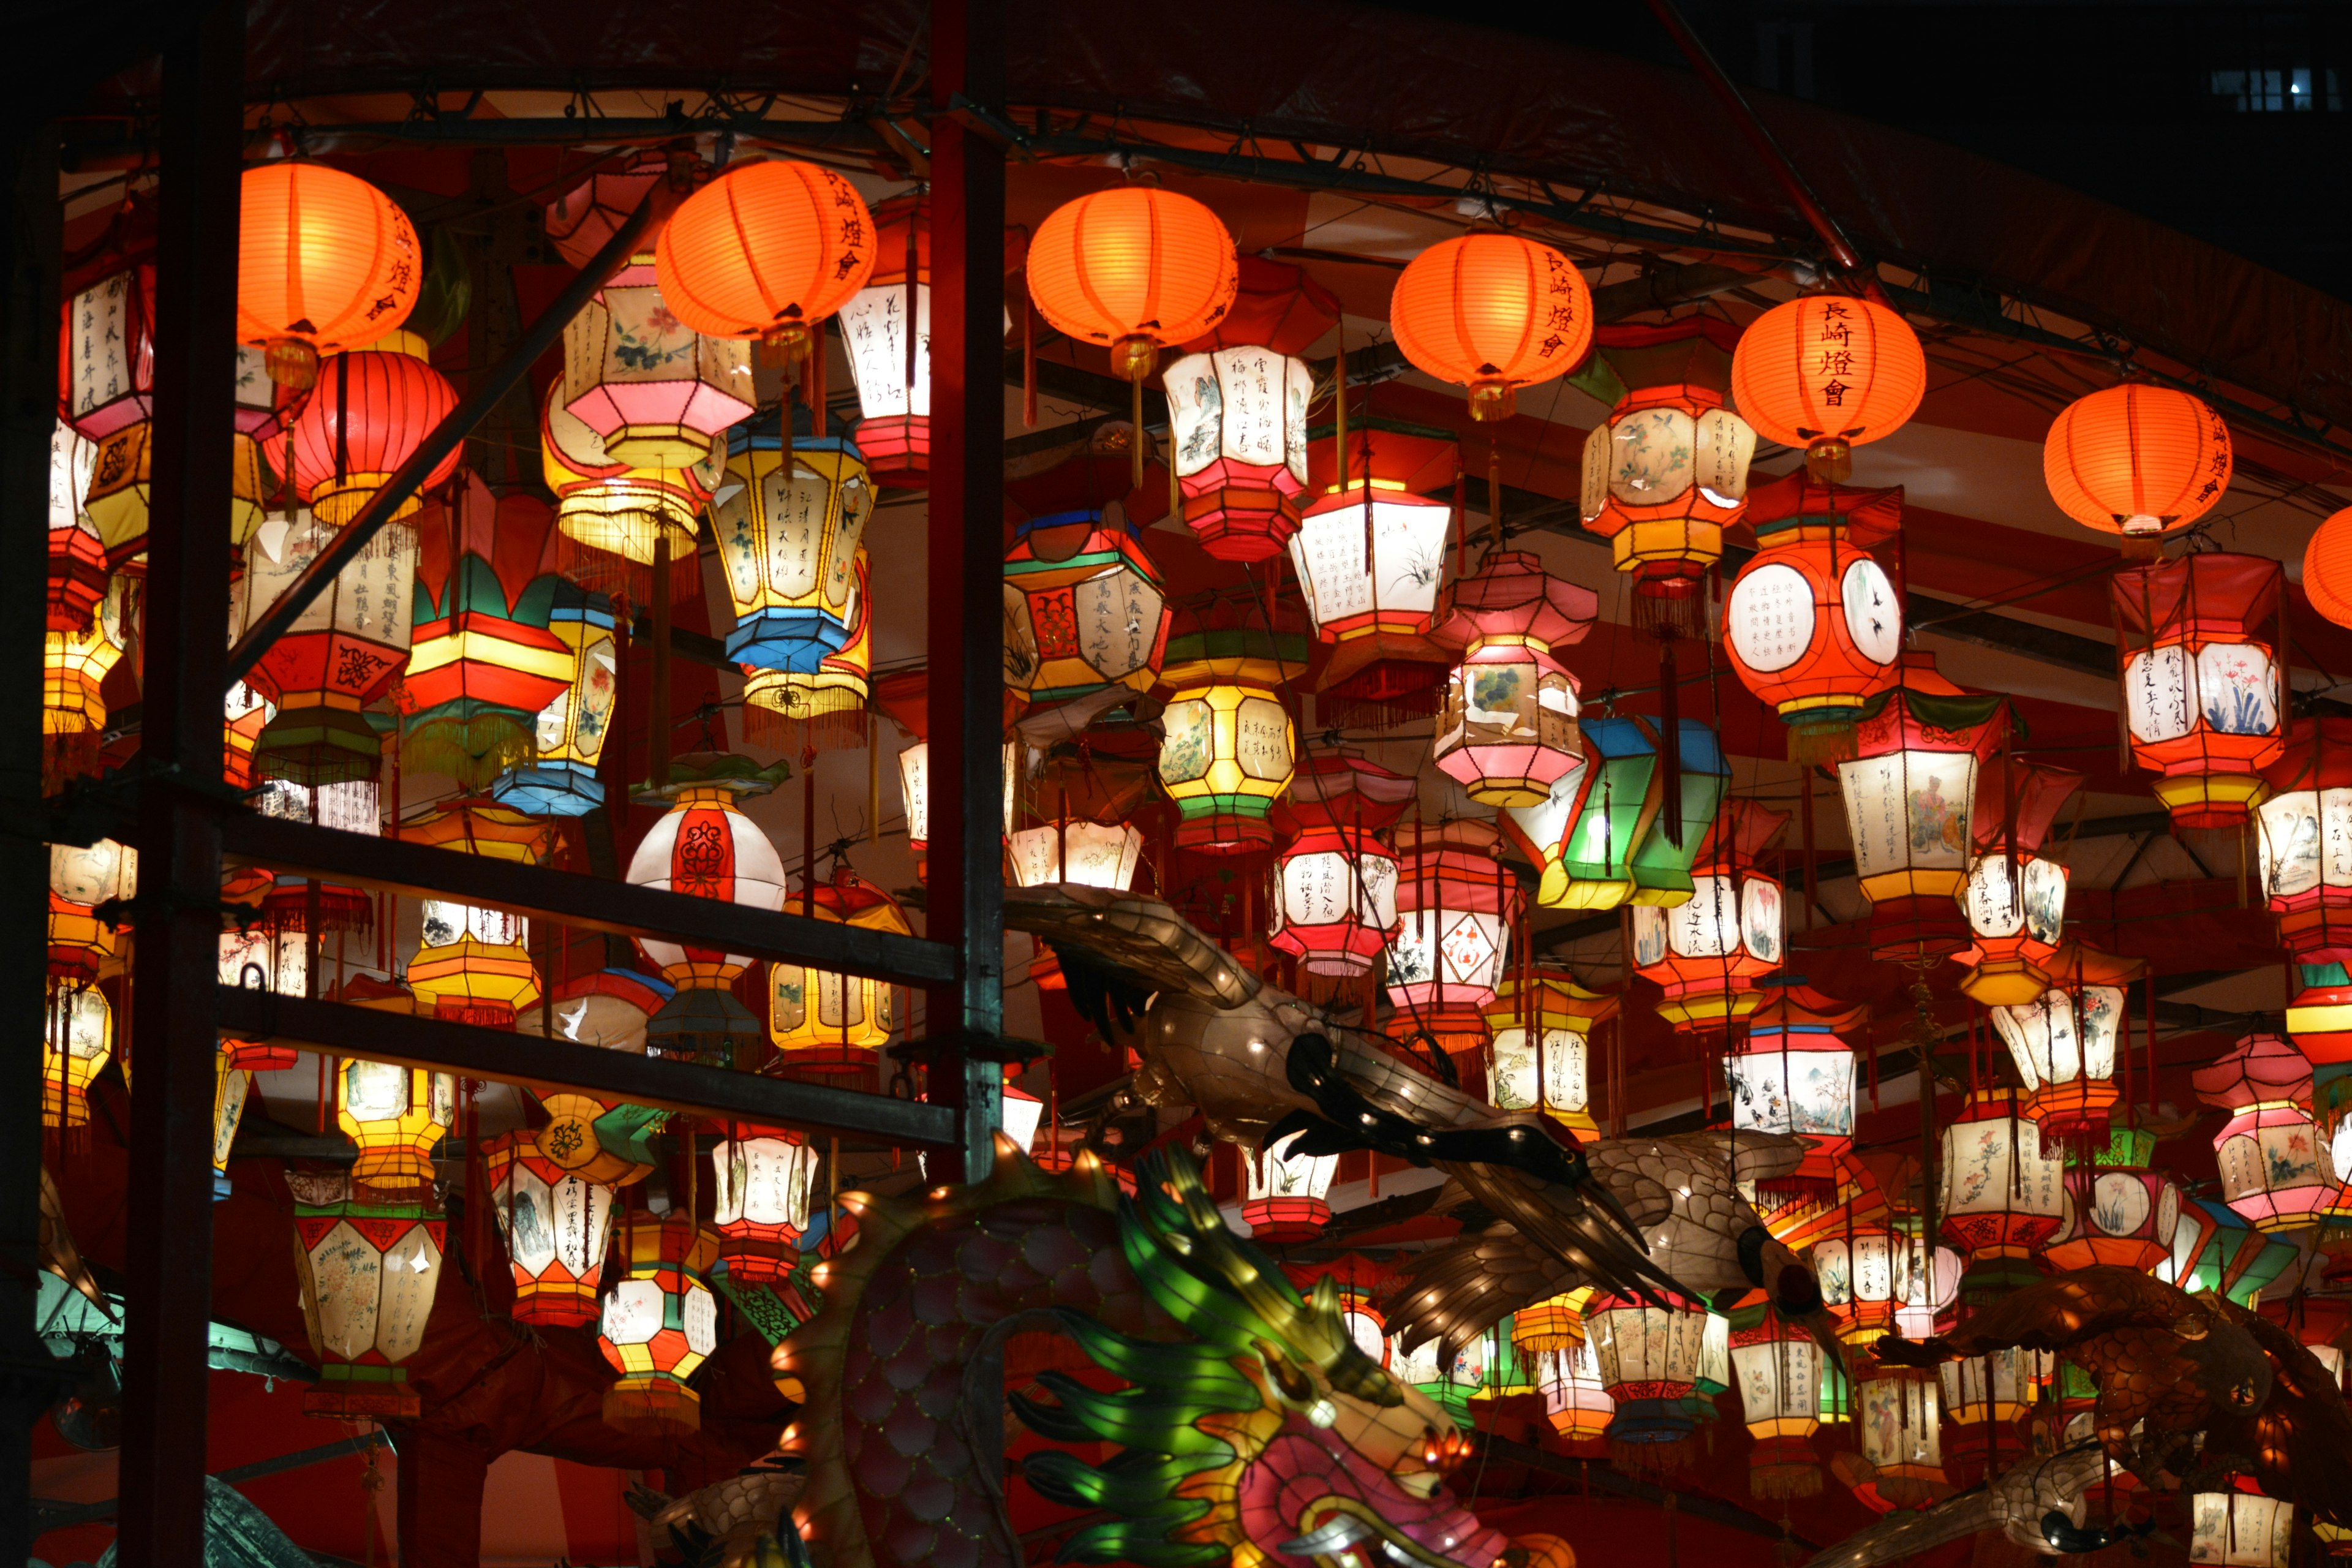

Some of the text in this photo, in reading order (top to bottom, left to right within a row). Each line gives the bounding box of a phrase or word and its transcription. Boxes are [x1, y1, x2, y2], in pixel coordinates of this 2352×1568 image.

[1538, 251, 1574, 358] 長崎燈會
[1817, 301, 1855, 407] 長崎燈會
